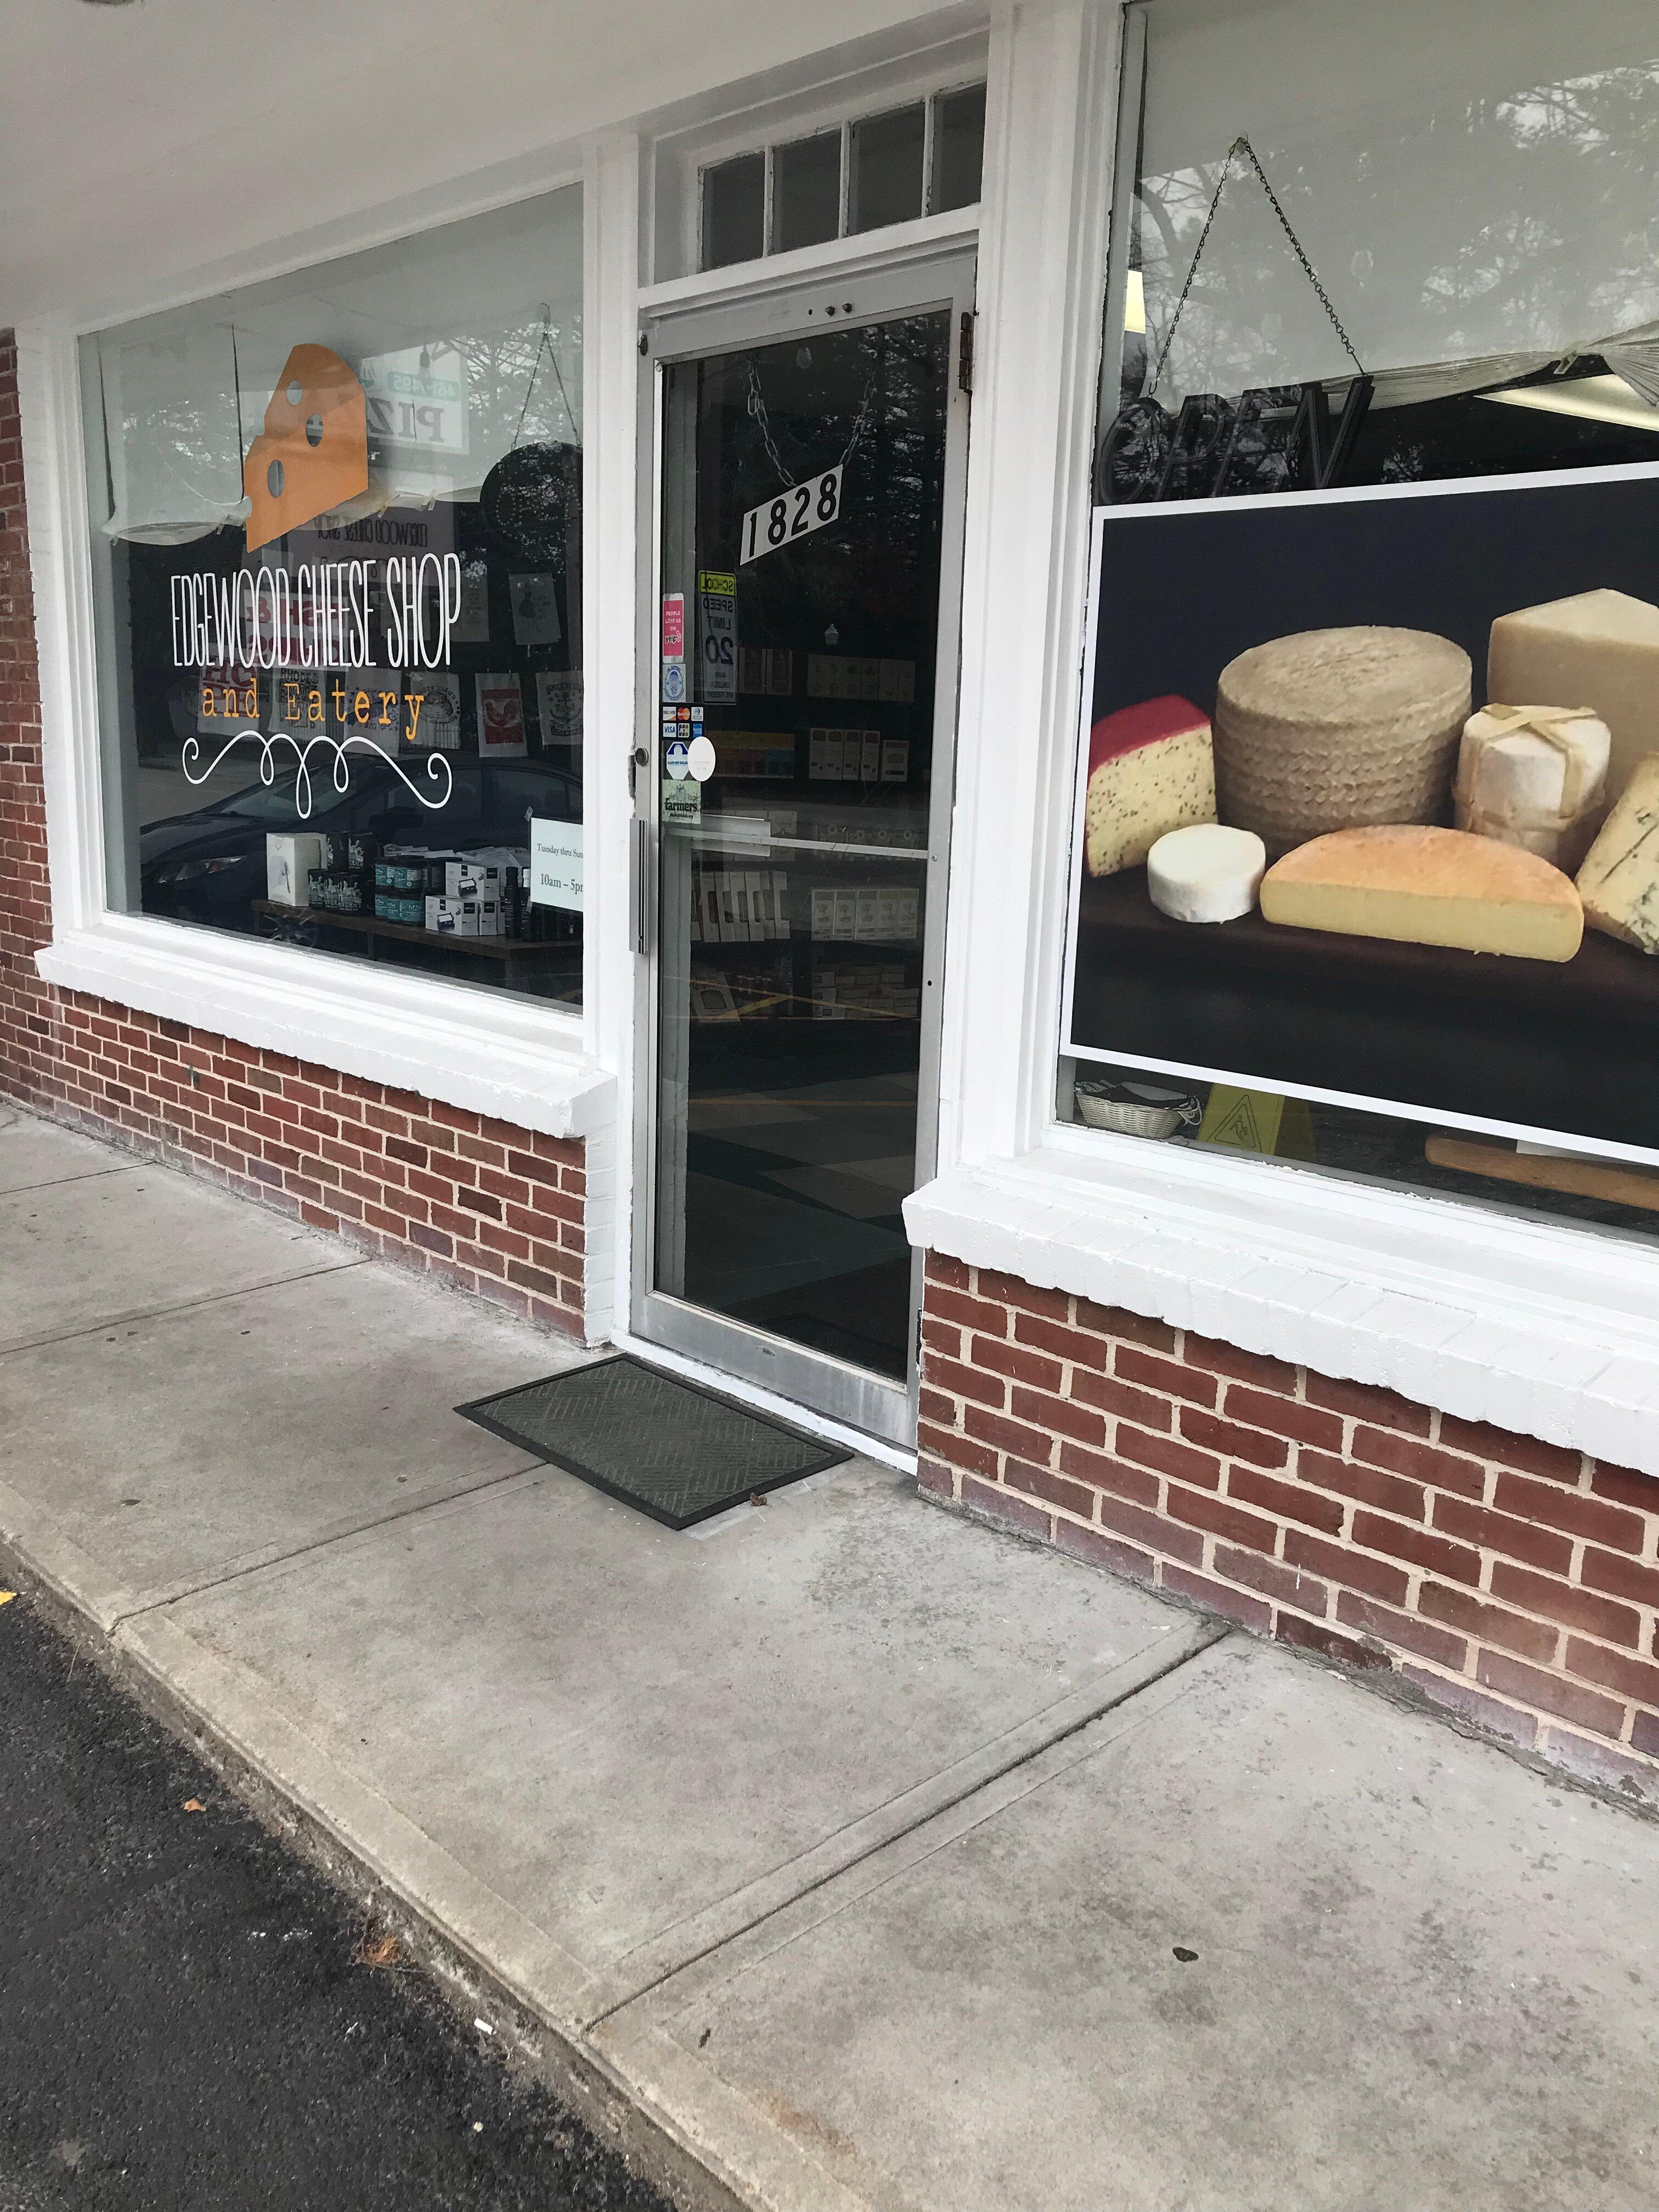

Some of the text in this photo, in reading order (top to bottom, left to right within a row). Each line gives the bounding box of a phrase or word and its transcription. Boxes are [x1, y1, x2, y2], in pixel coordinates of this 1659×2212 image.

[1099, 375, 1375, 505] OPEN
[749, 473, 837, 558] 1828
[171, 552, 461, 669] EDGEWOOD CHEESE SHOP
[665, 634, 678, 644] yelp
[202, 678, 425, 741] and Eatery
[664, 797, 698, 812] farmers
[537, 843, 560, 856] Tuesday
[560, 847, 572, 856] thru
[540, 873, 561, 888] 10am
